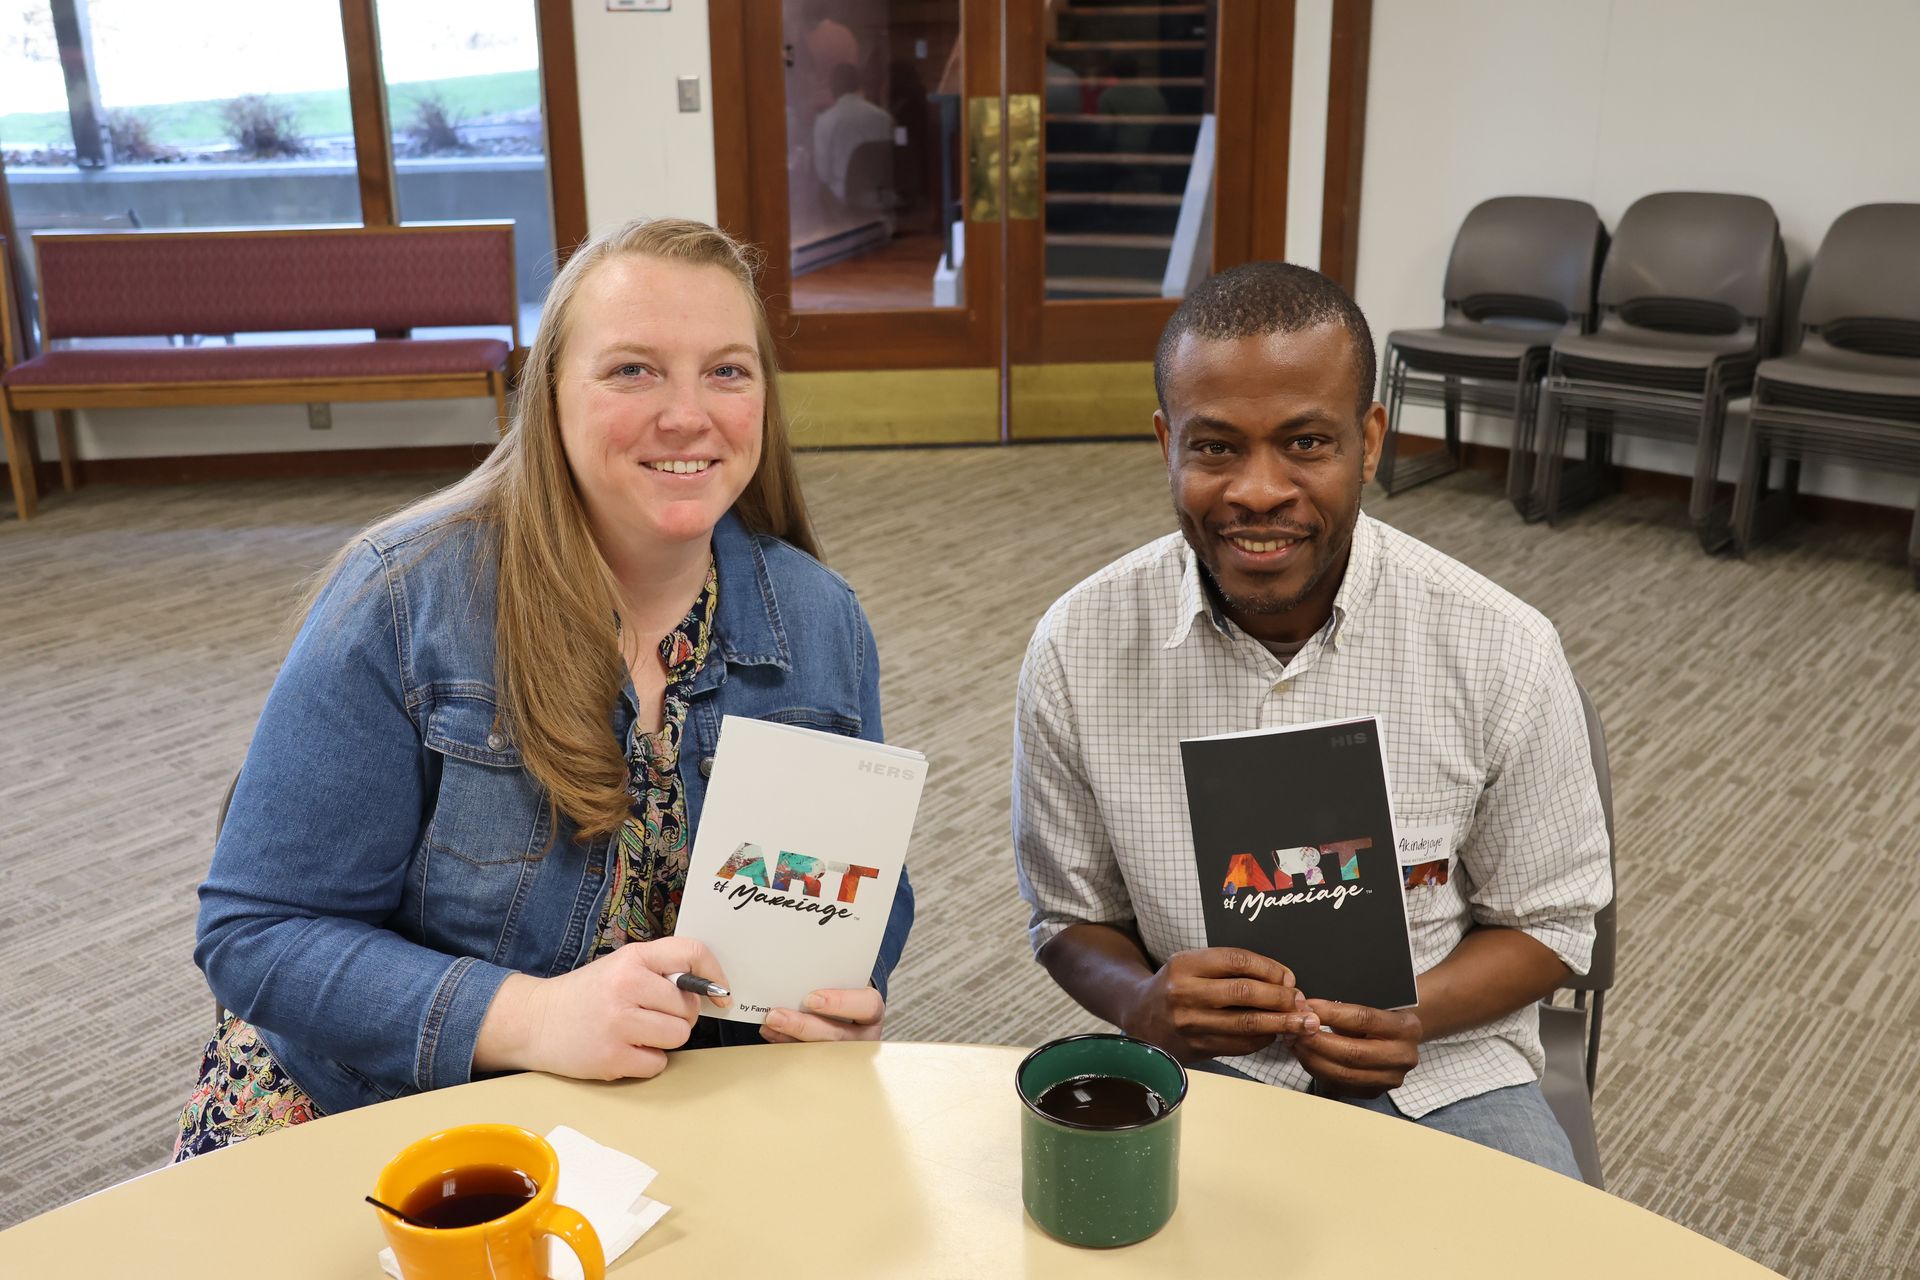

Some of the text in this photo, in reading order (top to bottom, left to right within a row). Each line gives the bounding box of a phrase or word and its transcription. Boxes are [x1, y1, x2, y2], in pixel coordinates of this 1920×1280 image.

[1331, 732, 1367, 748] HIS
[858, 760, 914, 780] HERS
[714, 842, 880, 903] ART
[1222, 837, 1373, 895] ART
[713, 881, 728, 893] of
[728, 884, 853, 926] Marriage
[1223, 895, 1237, 909] of
[1239, 884, 1364, 922] Marriage
[740, 1003, 750, 1012] by
